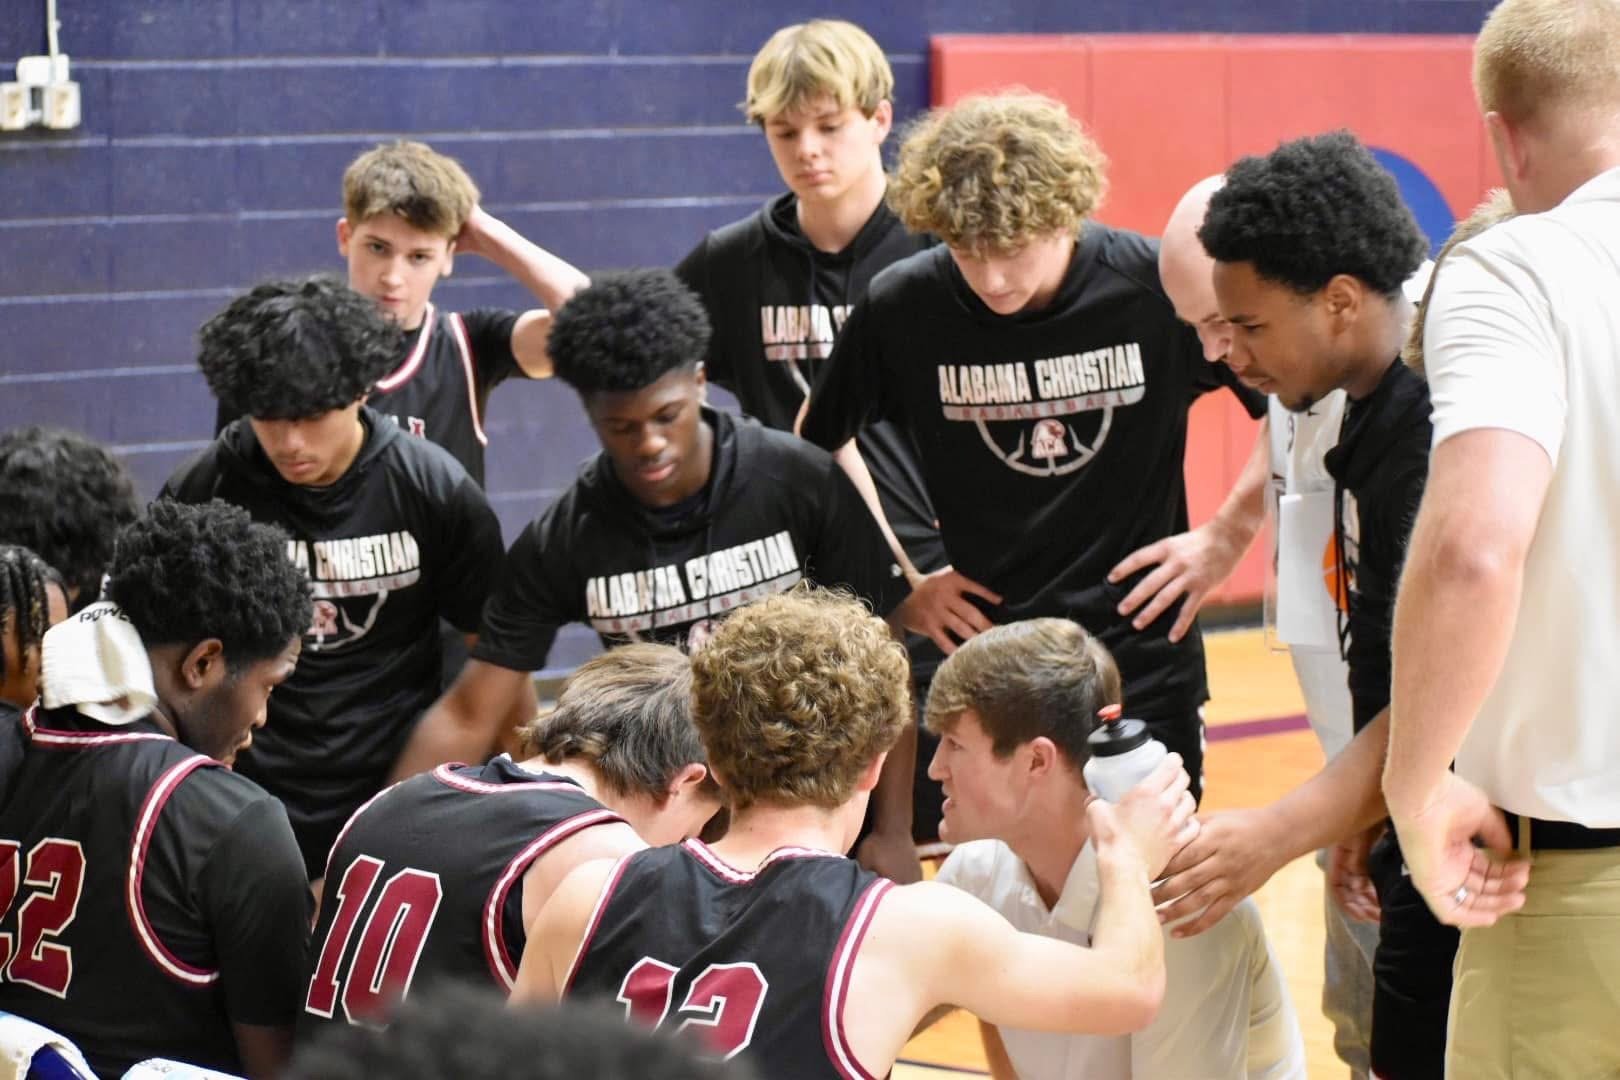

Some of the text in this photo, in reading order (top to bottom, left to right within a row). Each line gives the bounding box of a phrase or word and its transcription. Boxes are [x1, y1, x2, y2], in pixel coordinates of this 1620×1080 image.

[938, 343, 1144, 404] ALABAMA CHRISTIAN
[313, 530, 420, 580] CHRISTIAN
[586, 530, 799, 617] ALABAMA CHRISTIAN
[305, 854, 443, 1032] 10
